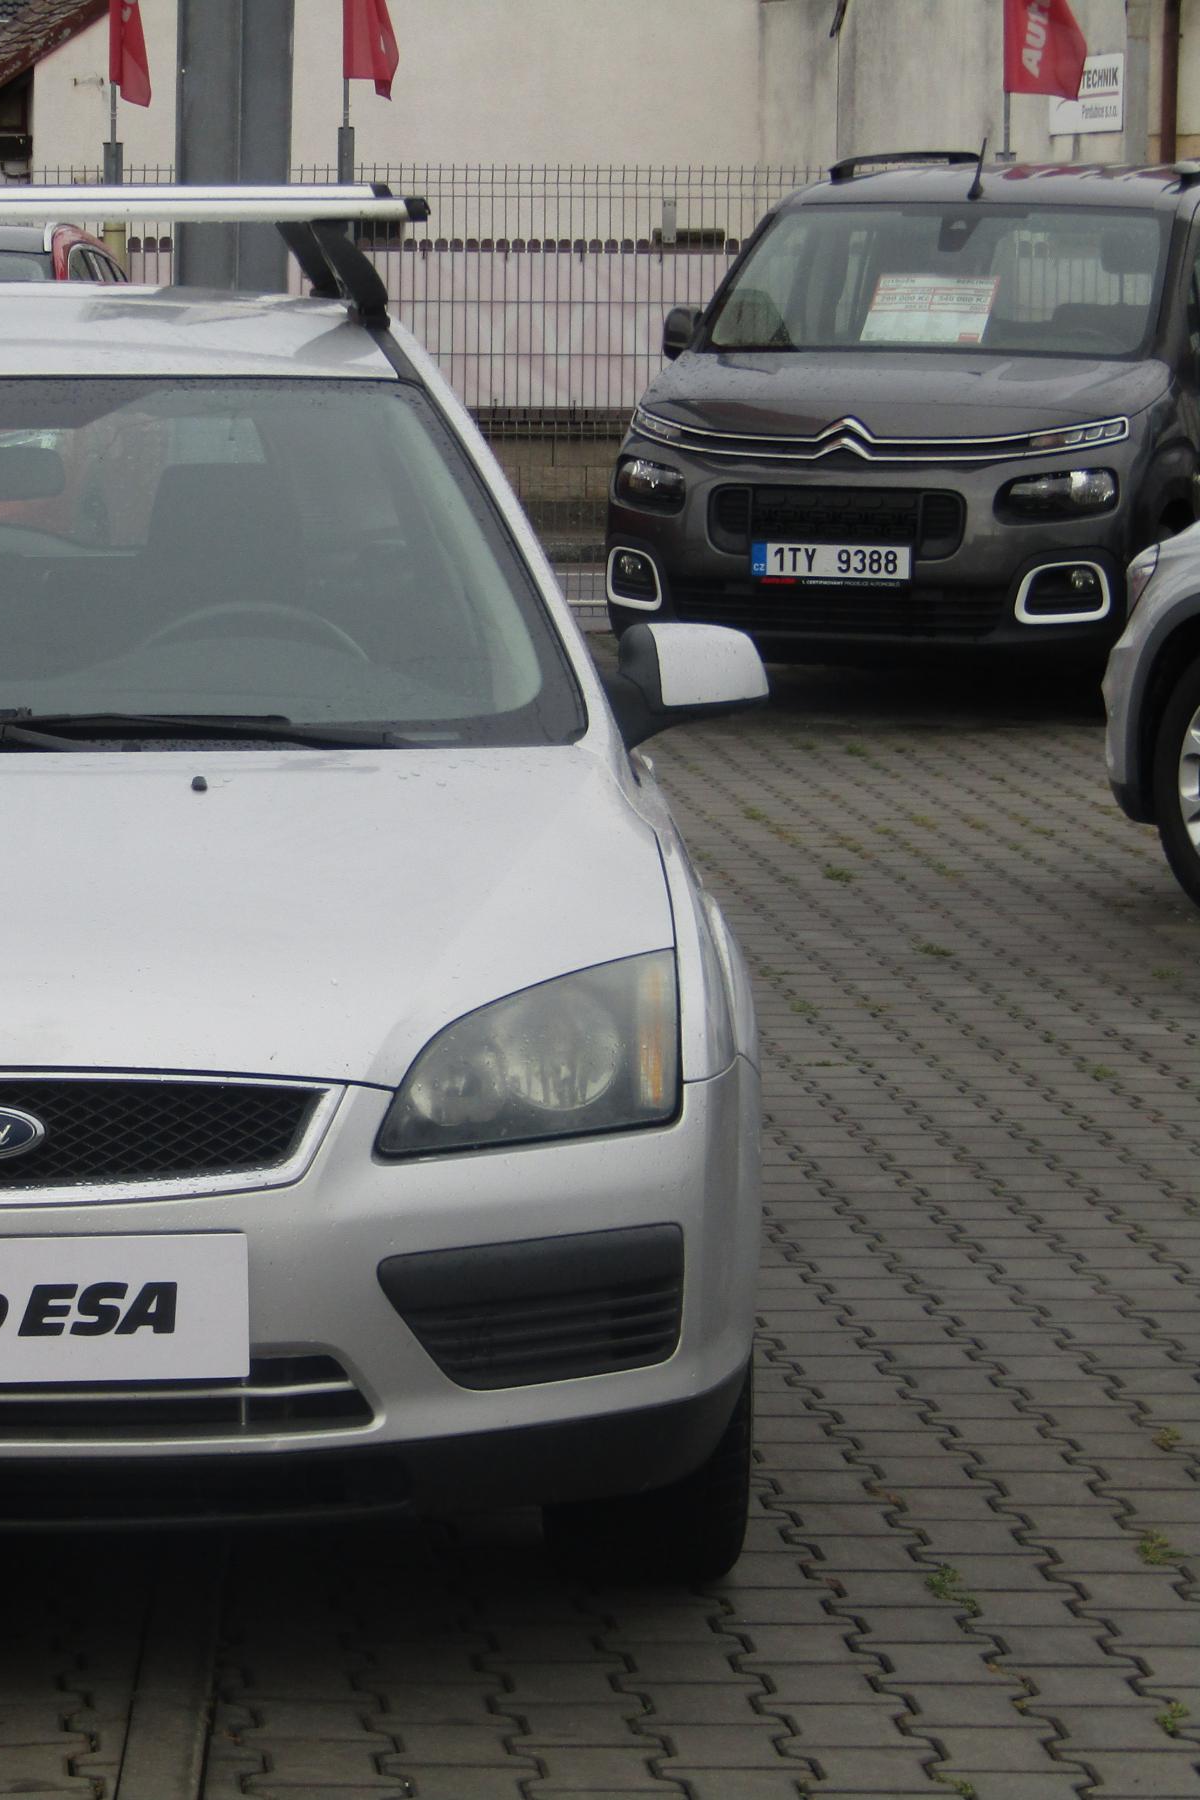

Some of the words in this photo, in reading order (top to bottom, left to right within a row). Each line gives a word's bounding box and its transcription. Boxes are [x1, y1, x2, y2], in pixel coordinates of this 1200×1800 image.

[753, 563, 765, 571] CZ
[774, 547, 817, 573] 1TY
[837, 549, 898, 574] 9388
[17, 1281, 178, 1337] ESA
